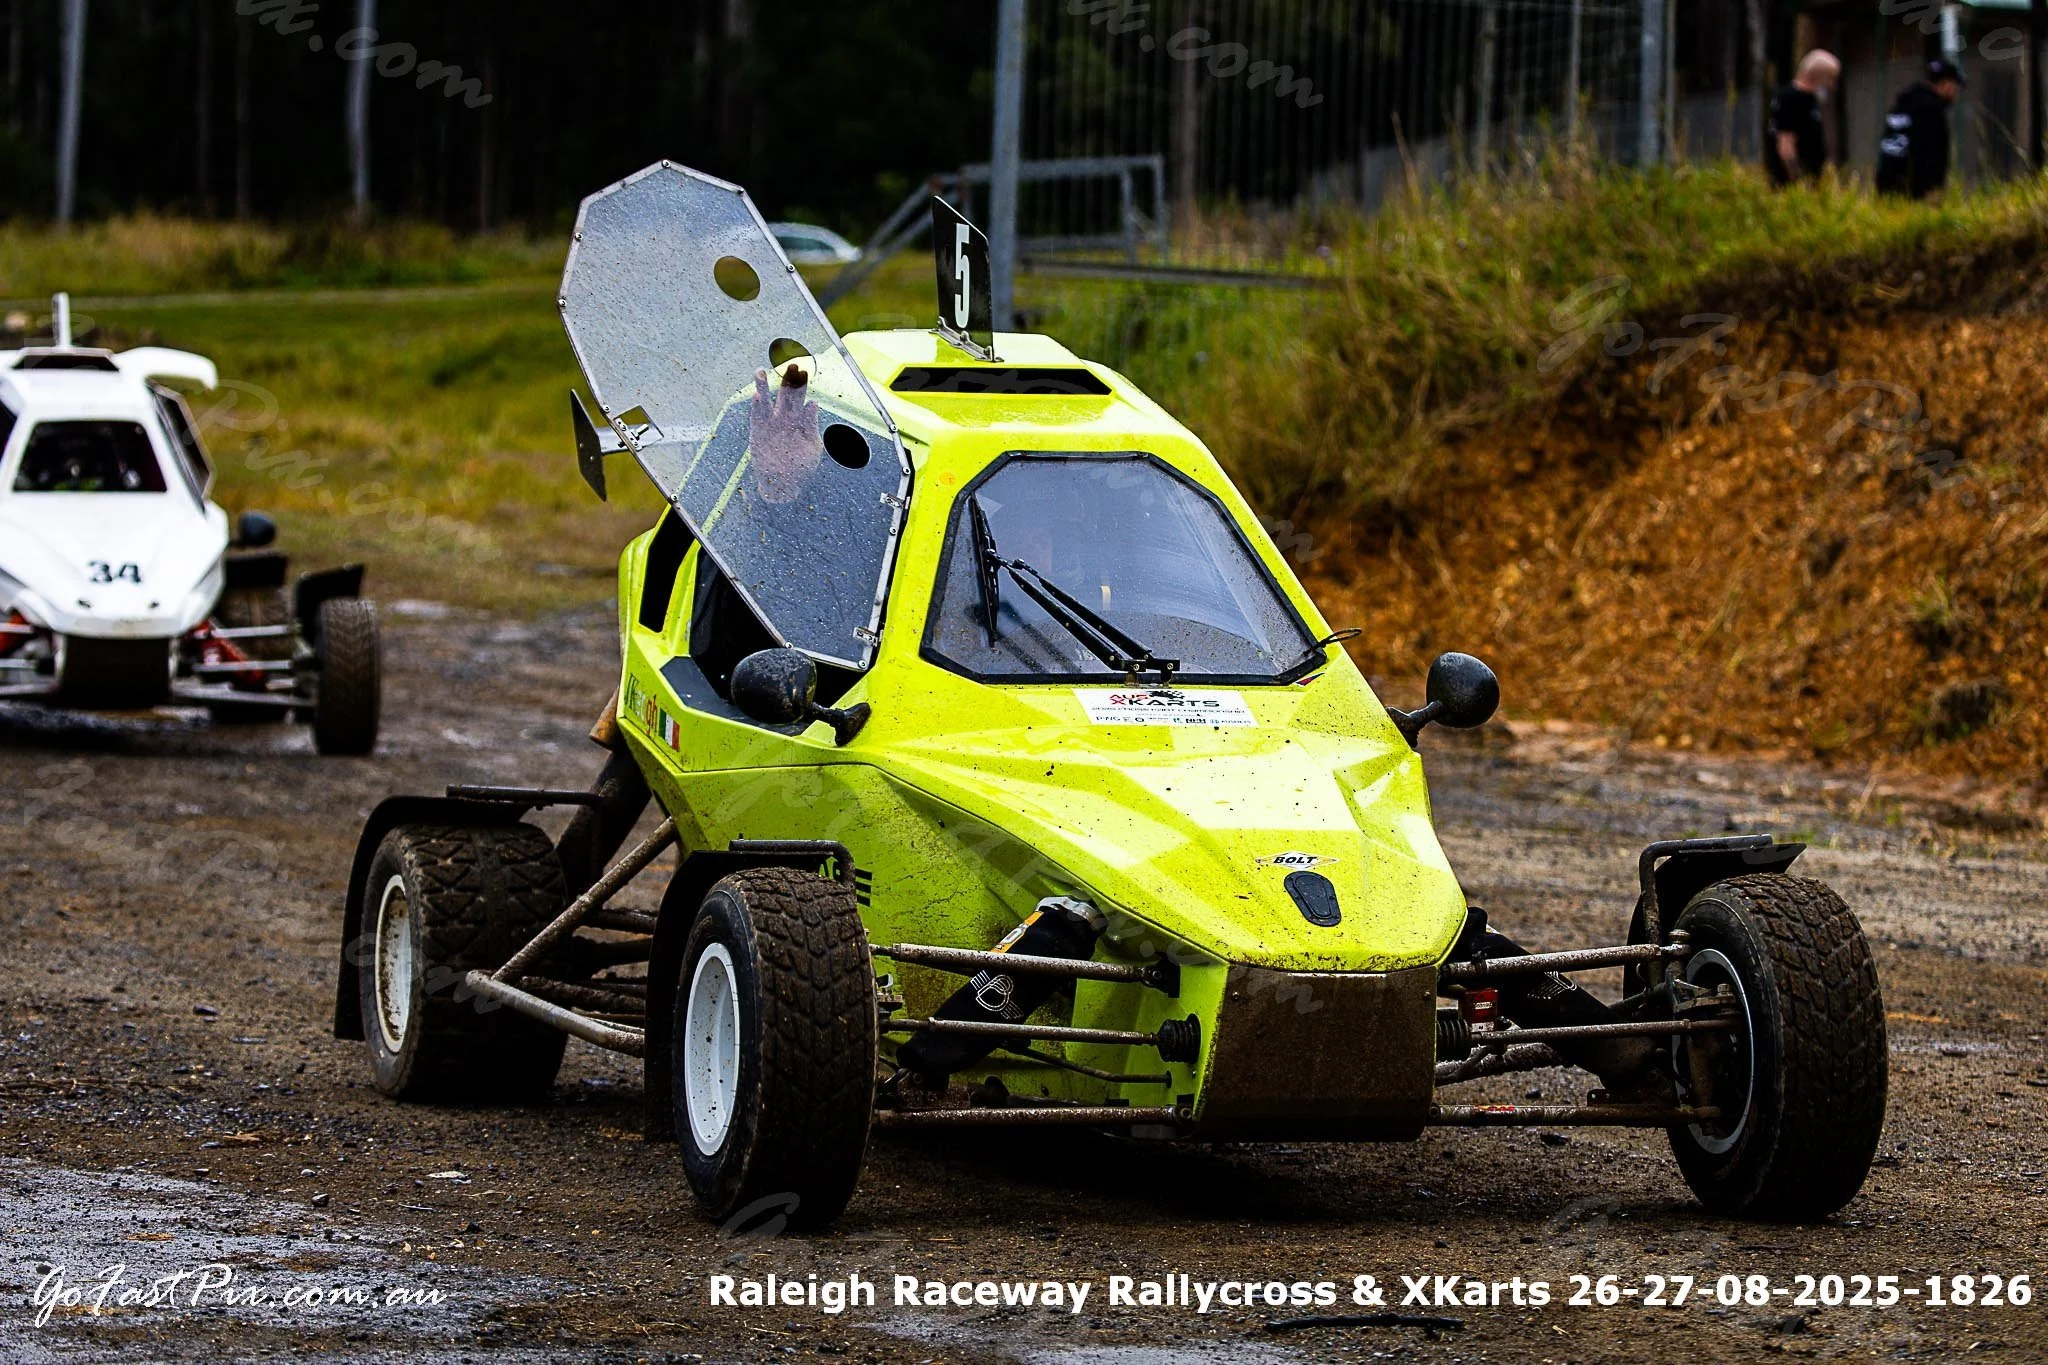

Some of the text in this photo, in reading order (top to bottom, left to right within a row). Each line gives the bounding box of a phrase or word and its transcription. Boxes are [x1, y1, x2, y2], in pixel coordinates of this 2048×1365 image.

[955, 222, 970, 328] 5
[87, 560, 142, 584] 34
[1111, 698, 1220, 708] XKARTS
[1273, 856, 1318, 864] BOLT
